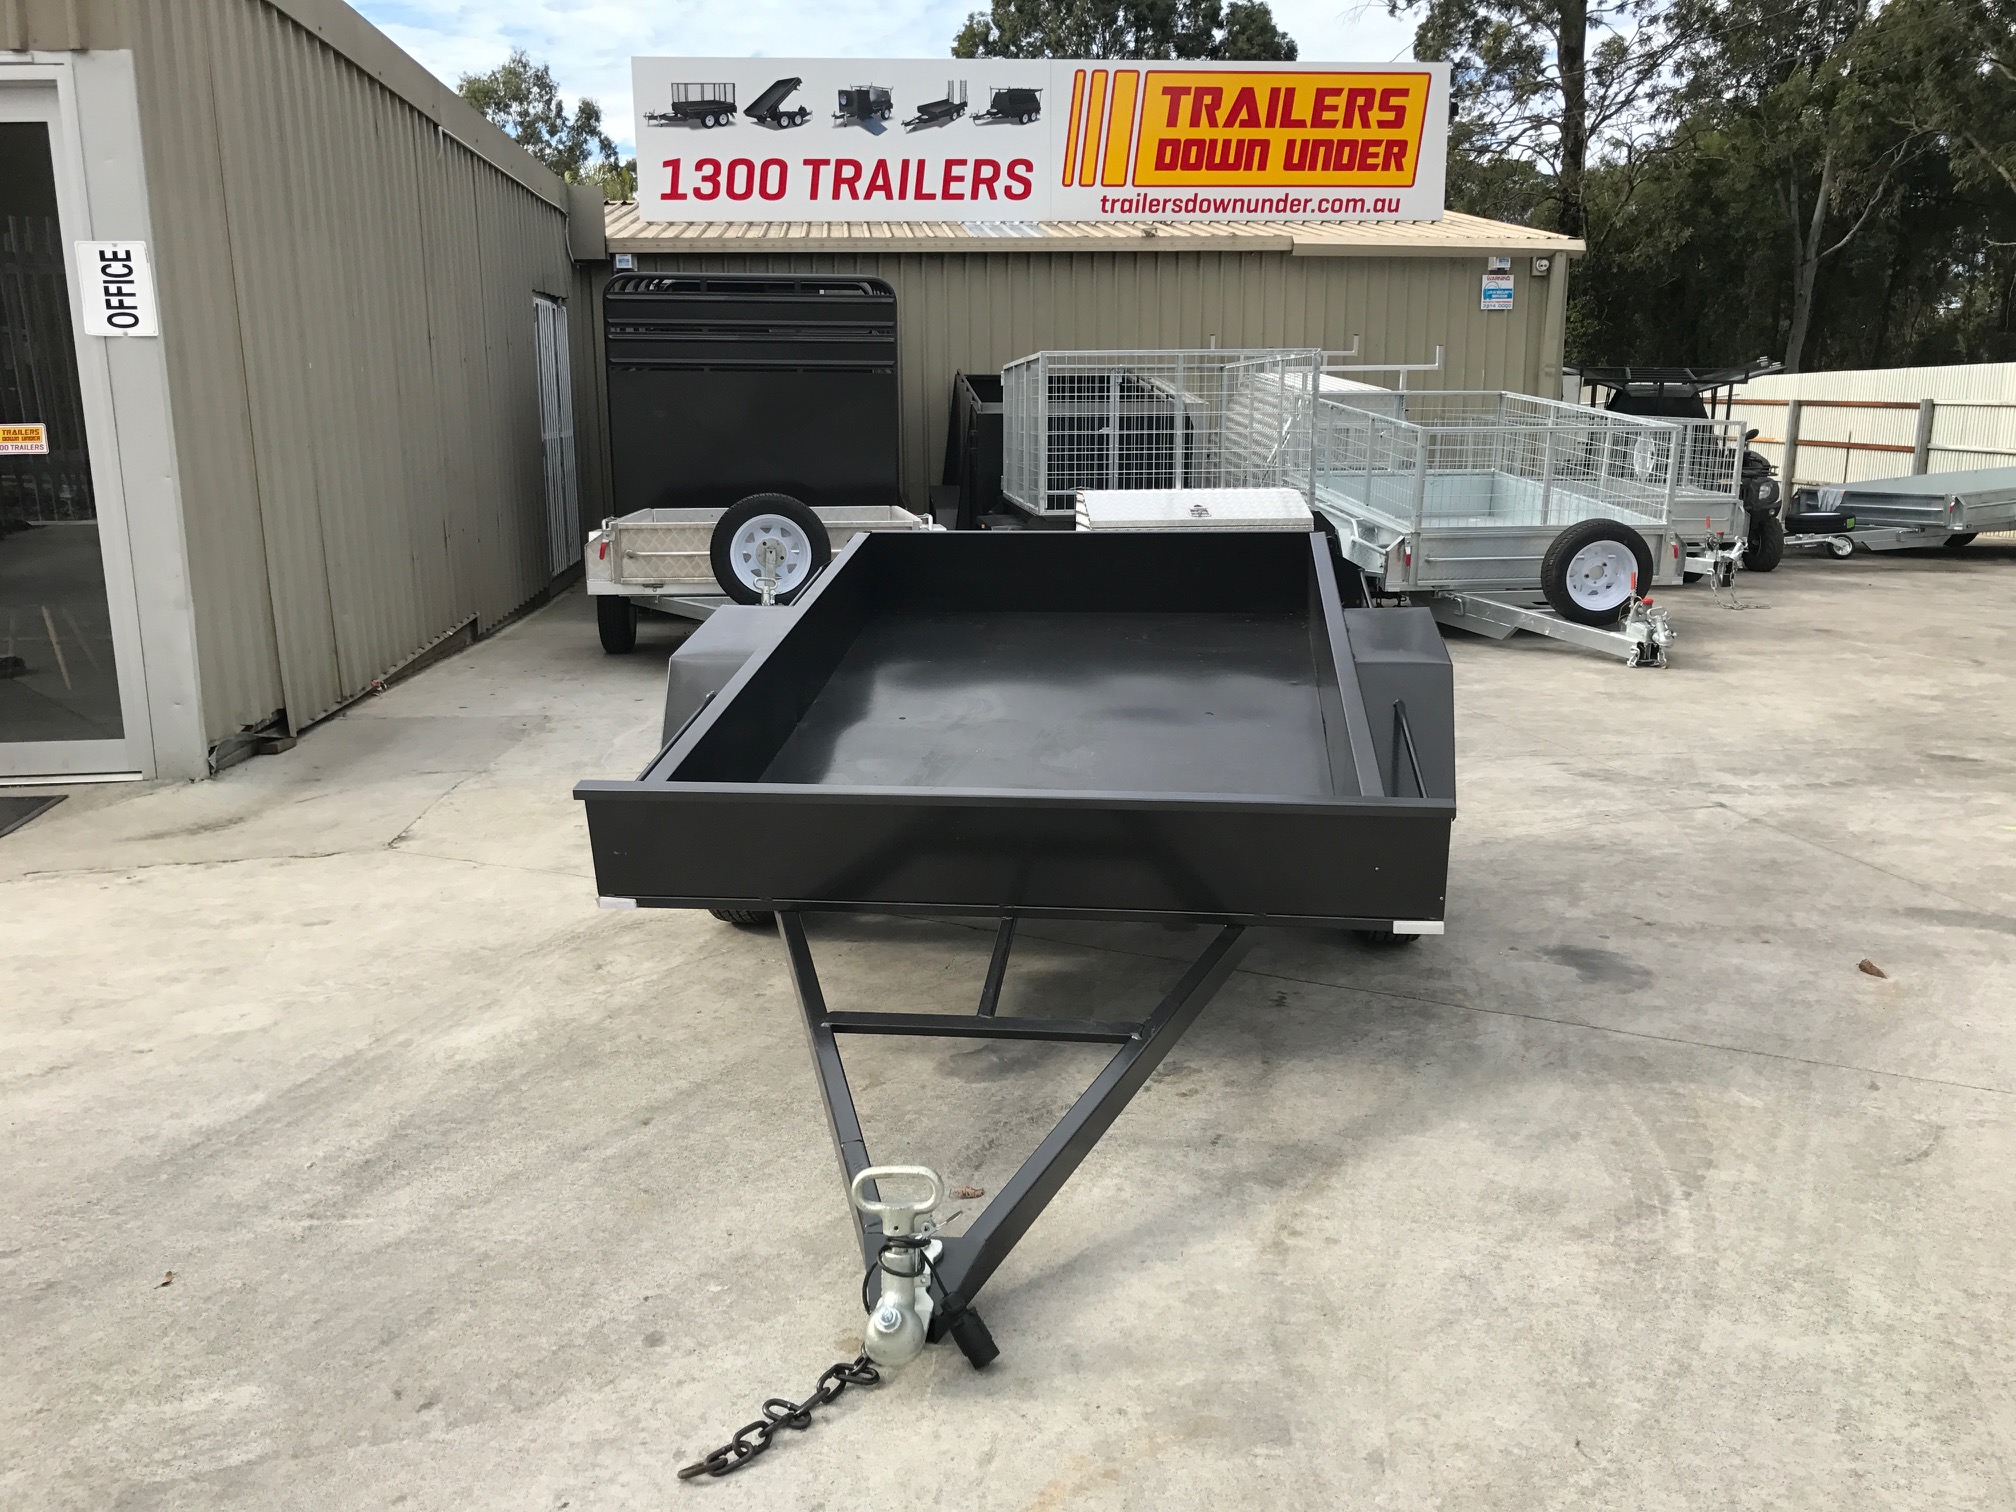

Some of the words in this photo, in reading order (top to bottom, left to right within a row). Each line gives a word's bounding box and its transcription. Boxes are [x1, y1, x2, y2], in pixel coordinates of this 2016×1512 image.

[1161, 86, 1410, 129] TRAILERS
[1154, 138, 1270, 172] DOWN
[1283, 139, 1408, 172] UNDER
[660, 157, 789, 201] 1300
[802, 158, 1034, 201] TRAILERS
[1100, 192, 1401, 214] trailersdownunder.com.au
[98, 249, 140, 329] OFFICE
[10, 443, 45, 451] TRAILERS
